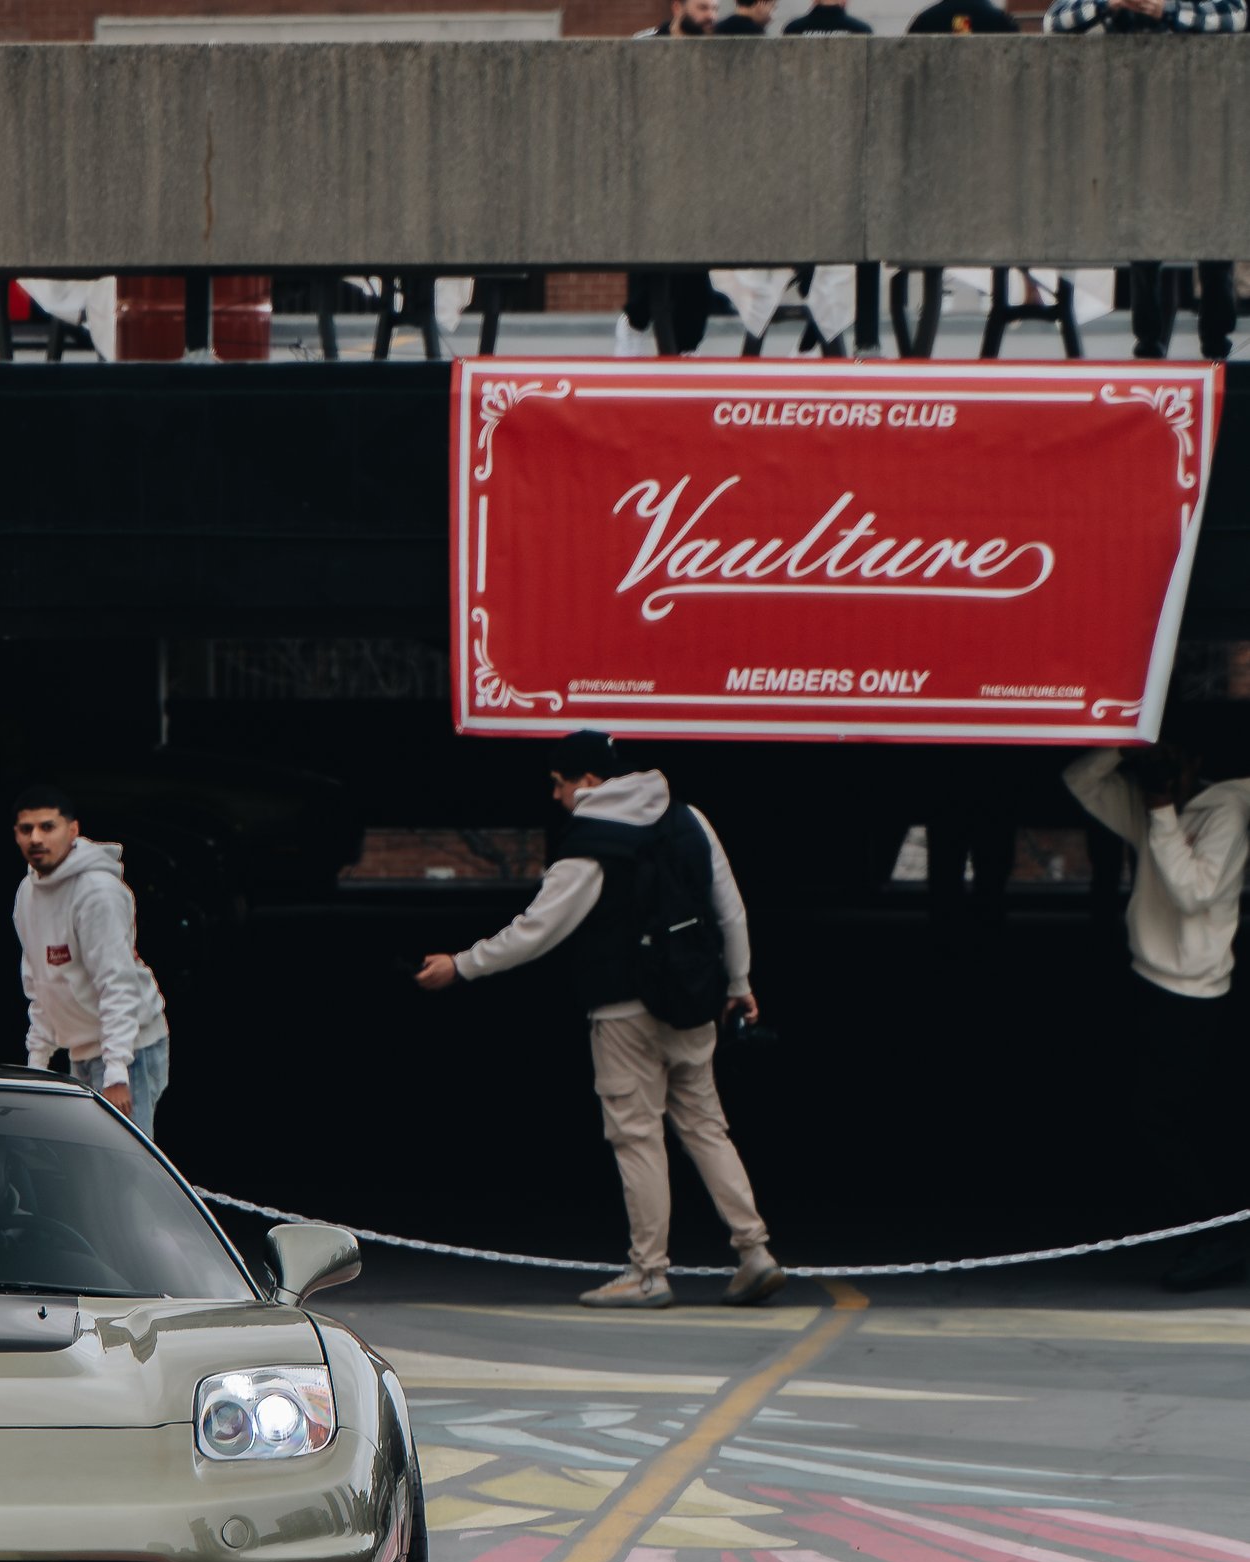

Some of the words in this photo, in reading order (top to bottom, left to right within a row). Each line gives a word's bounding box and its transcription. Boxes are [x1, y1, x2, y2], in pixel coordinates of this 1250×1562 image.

[713, 402, 882, 426] COLLECTORS
[887, 403, 957, 427] CLUB
[613, 475, 1055, 621] Vaulture
[568, 680, 655, 692] @THEVAULTURE
[726, 667, 855, 692] MEMBERS
[859, 669, 931, 693] ONLY
[980, 684, 1086, 698] THEVAULTURE.COM
